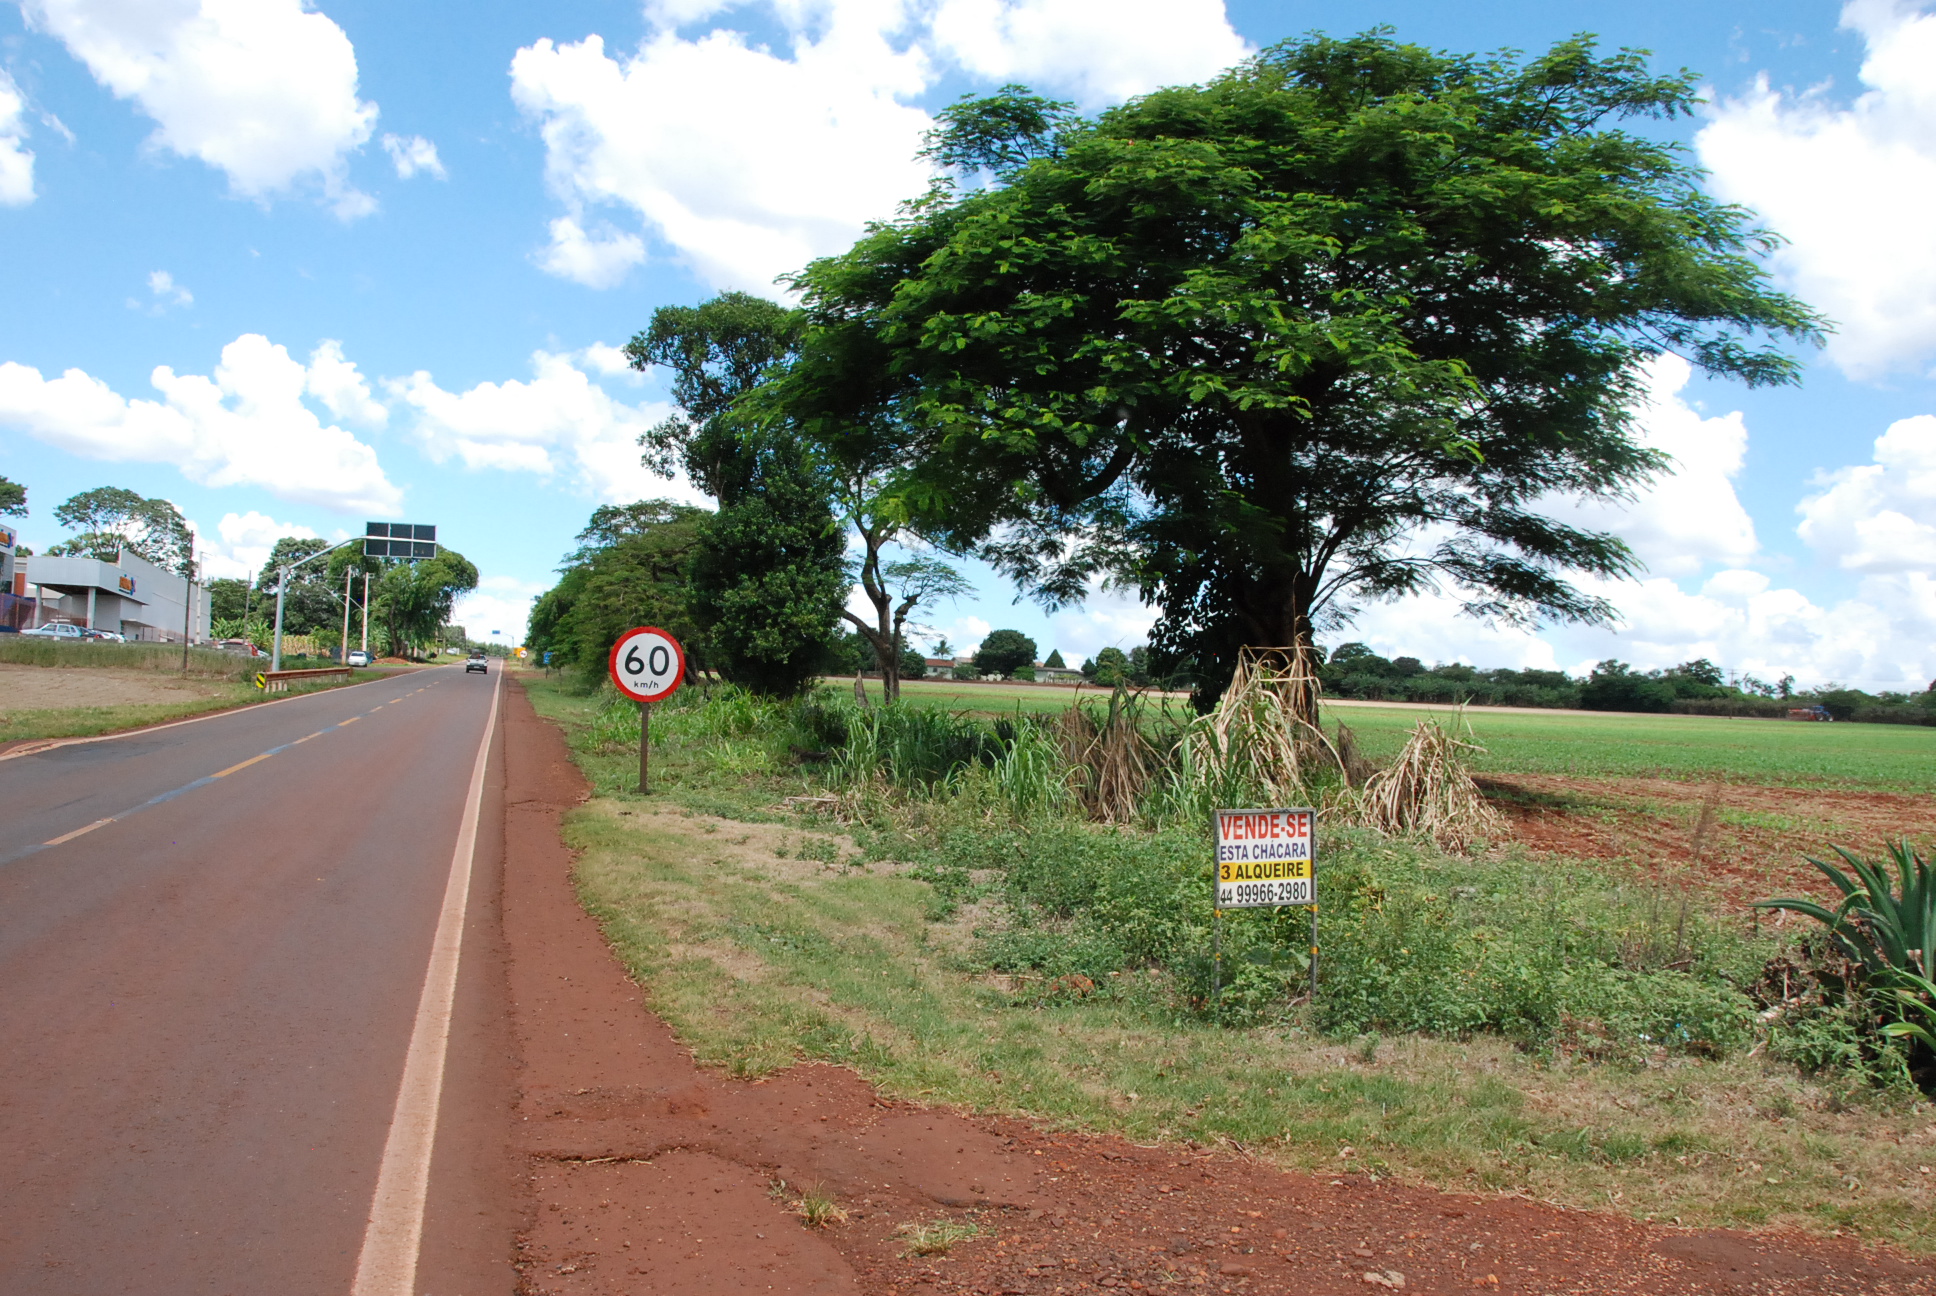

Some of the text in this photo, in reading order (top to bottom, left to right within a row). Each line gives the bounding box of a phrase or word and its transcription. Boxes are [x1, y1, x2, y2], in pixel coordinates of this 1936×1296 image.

[625, 645, 669, 676] 60
[634, 680, 659, 689] km/h
[1220, 813, 1308, 840] VENDE-SE
[1220, 840, 1307, 861] ESTA CHÁCARA
[1221, 862, 1304, 880] 3 ALQUEIRE
[1220, 881, 1307, 904] 44 99966-2980
